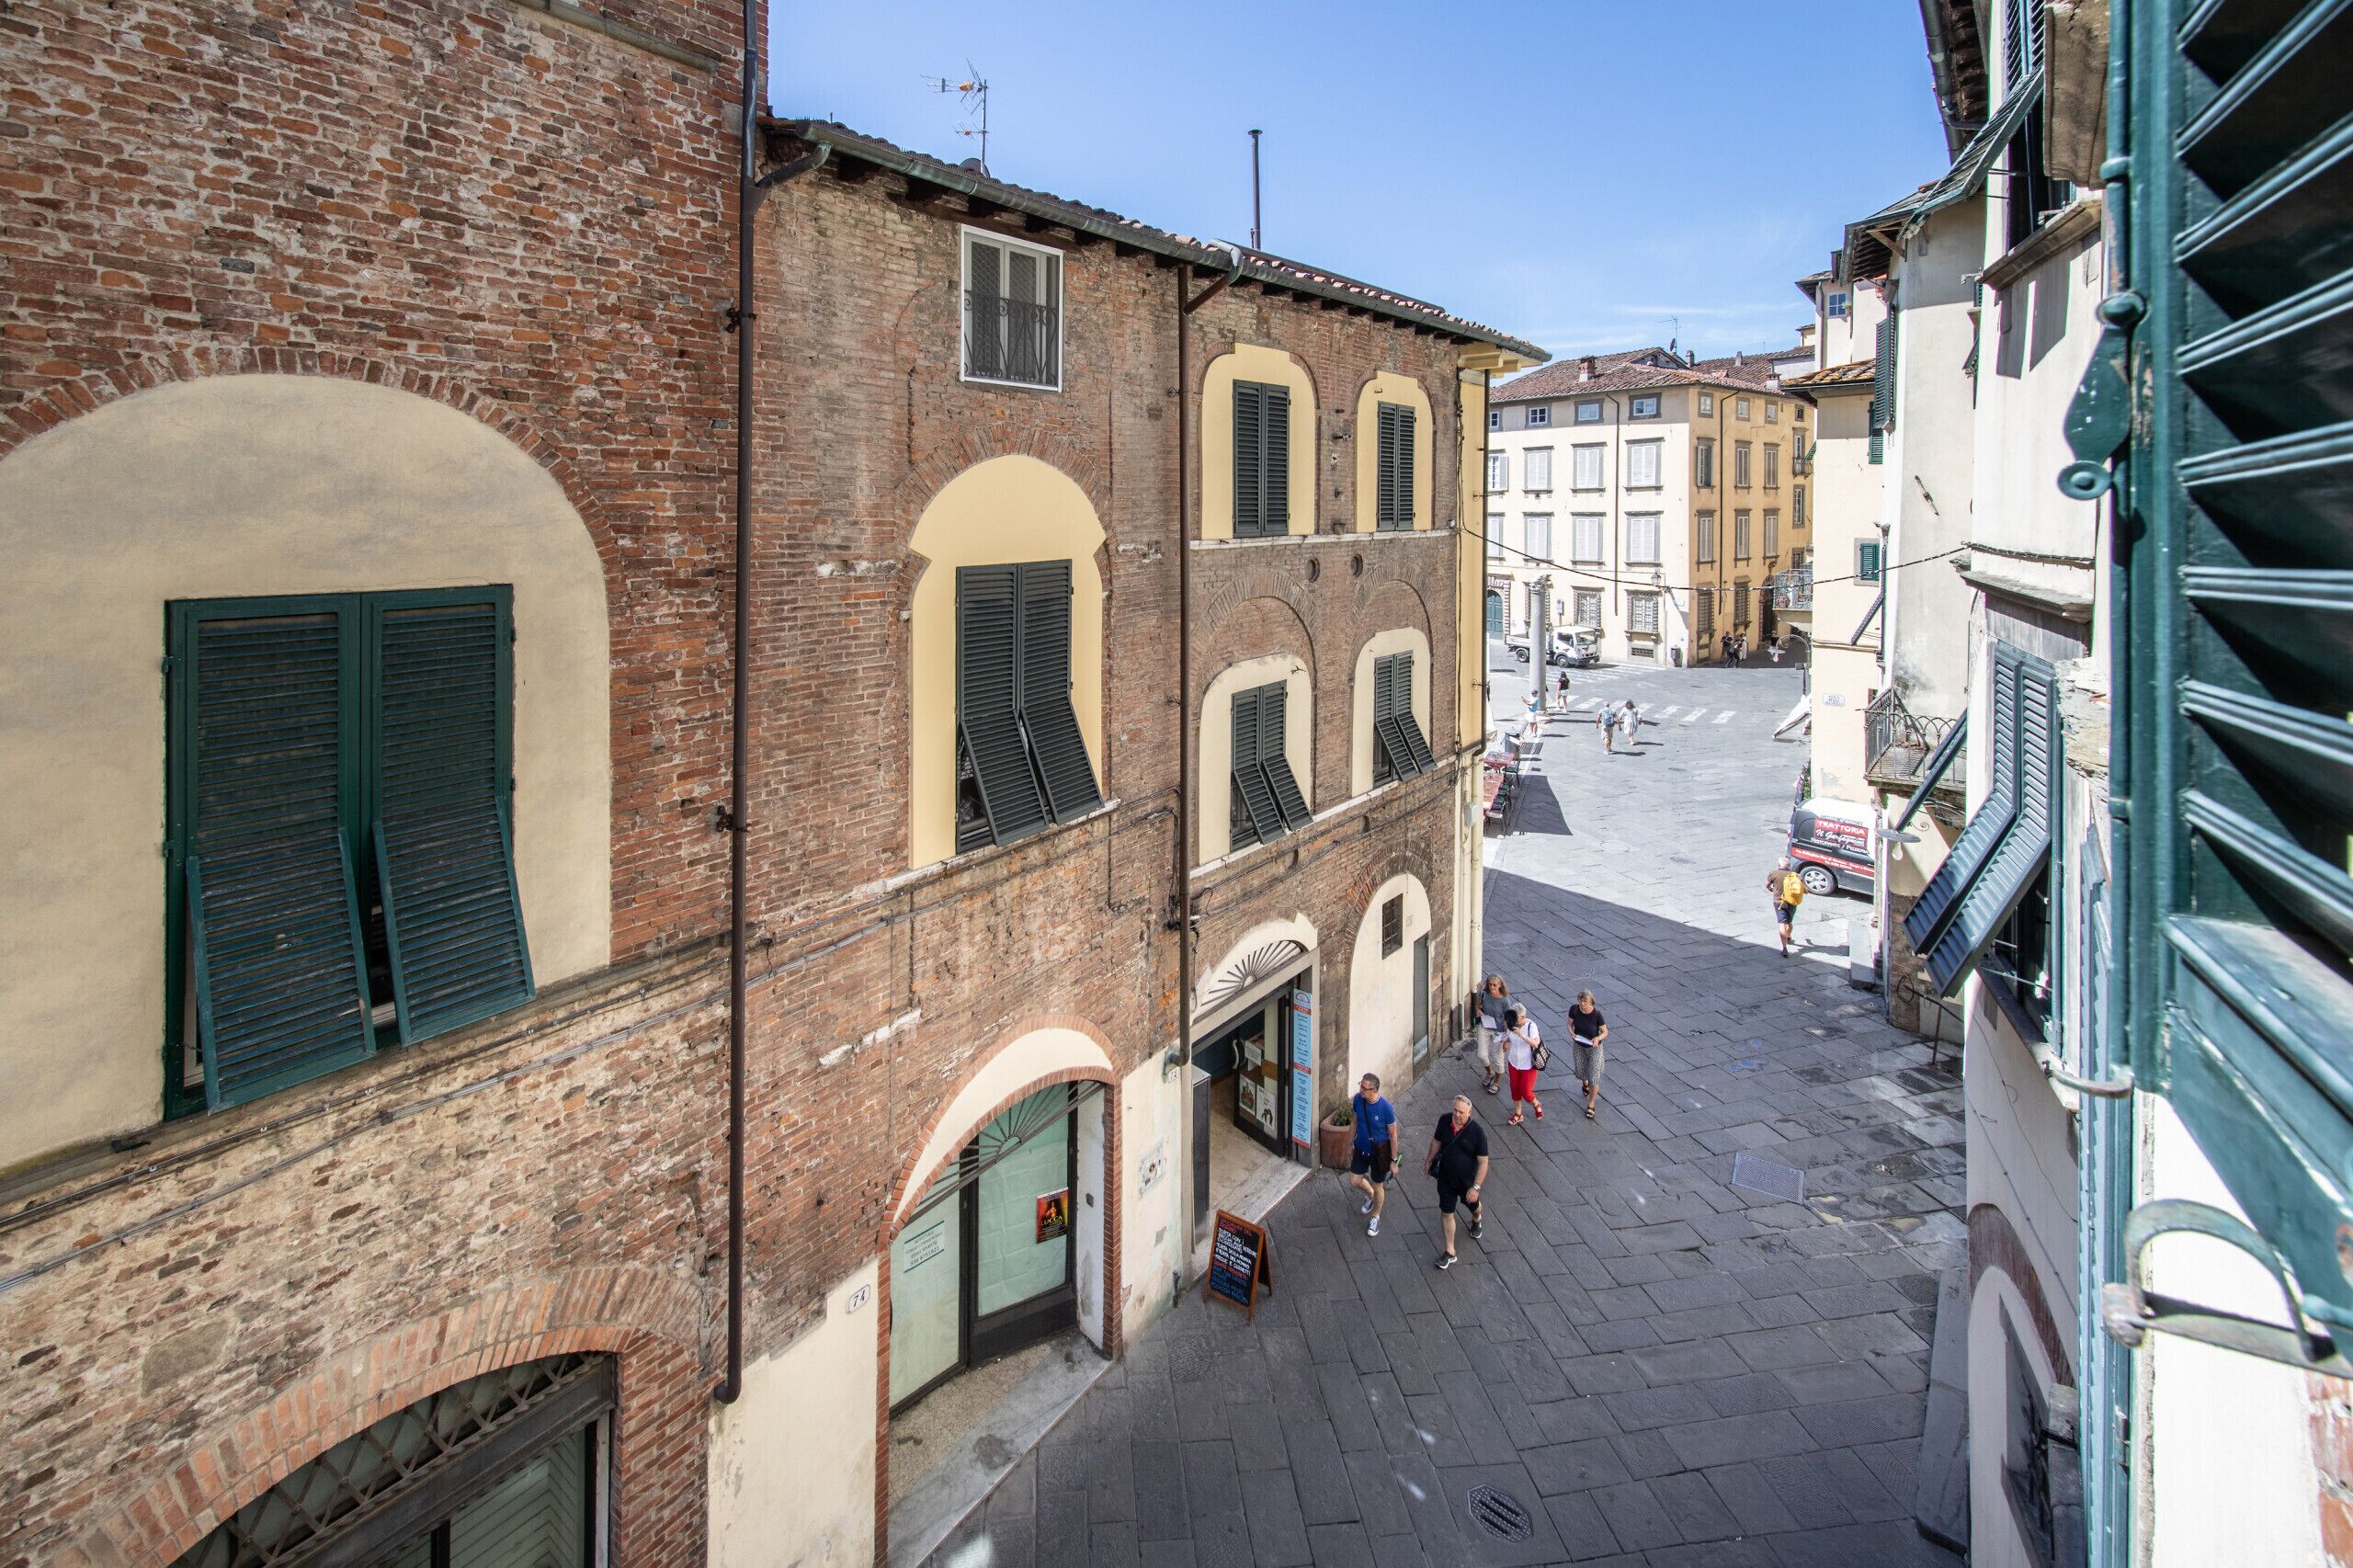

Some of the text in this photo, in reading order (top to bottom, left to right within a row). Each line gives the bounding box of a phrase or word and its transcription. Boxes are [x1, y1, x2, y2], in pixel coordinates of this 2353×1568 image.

[1817, 821, 1866, 835] TRATTORIA
[1040, 1215, 1063, 1226] LUCCA
[1218, 1227, 1232, 1237] TORTA
[853, 1290, 866, 1308] 74
